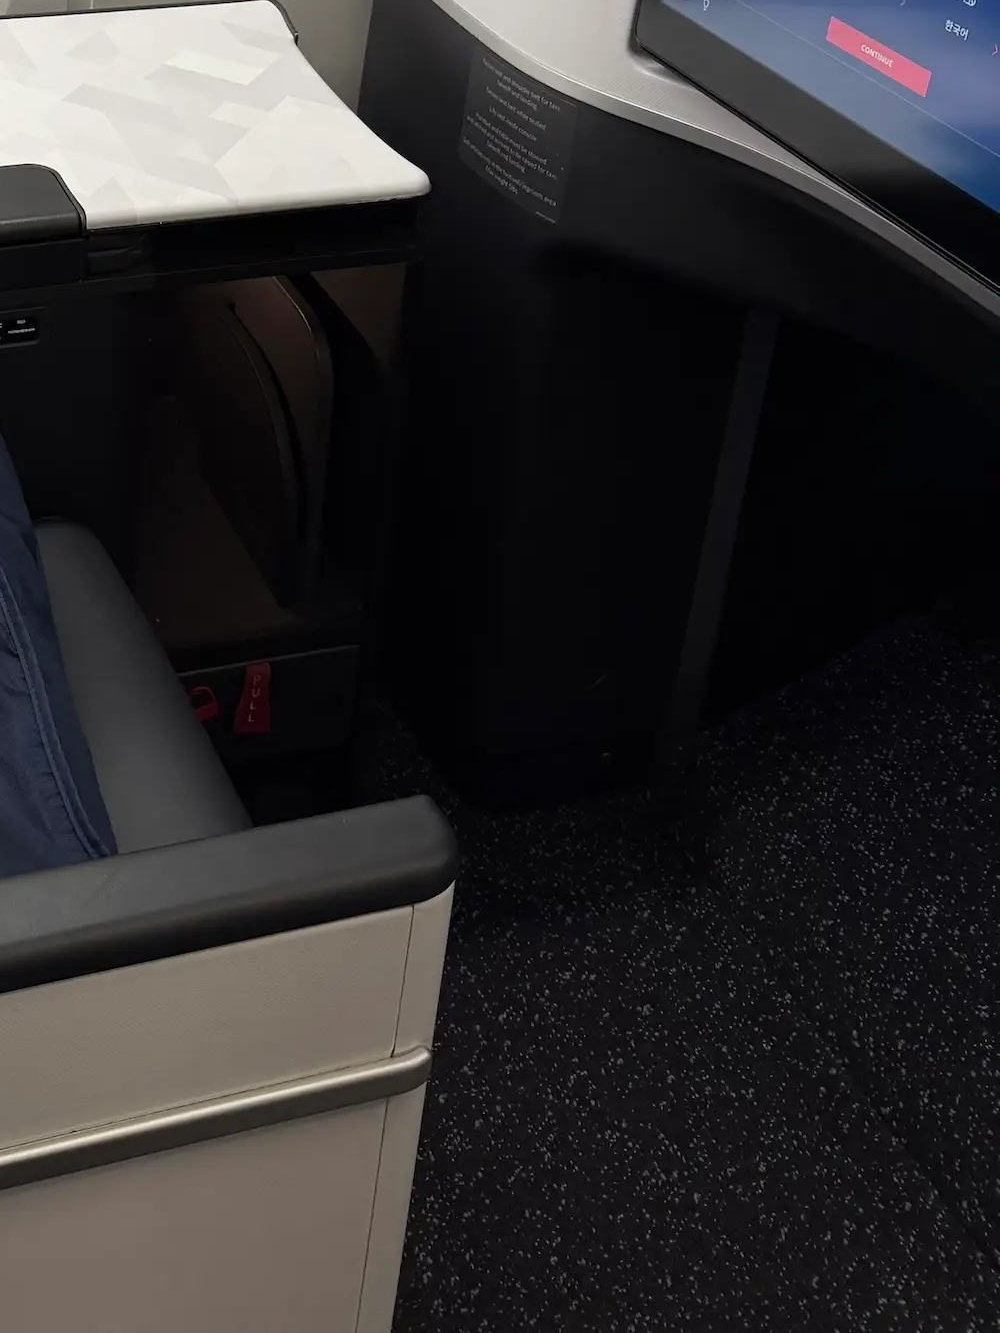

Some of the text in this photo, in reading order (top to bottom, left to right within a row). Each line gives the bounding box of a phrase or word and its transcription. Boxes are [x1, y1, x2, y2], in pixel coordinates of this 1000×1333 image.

[944, 19, 969, 41] 한국어
[860, 44, 894, 68] CONTINUE
[247, 674, 261, 722] PULL
